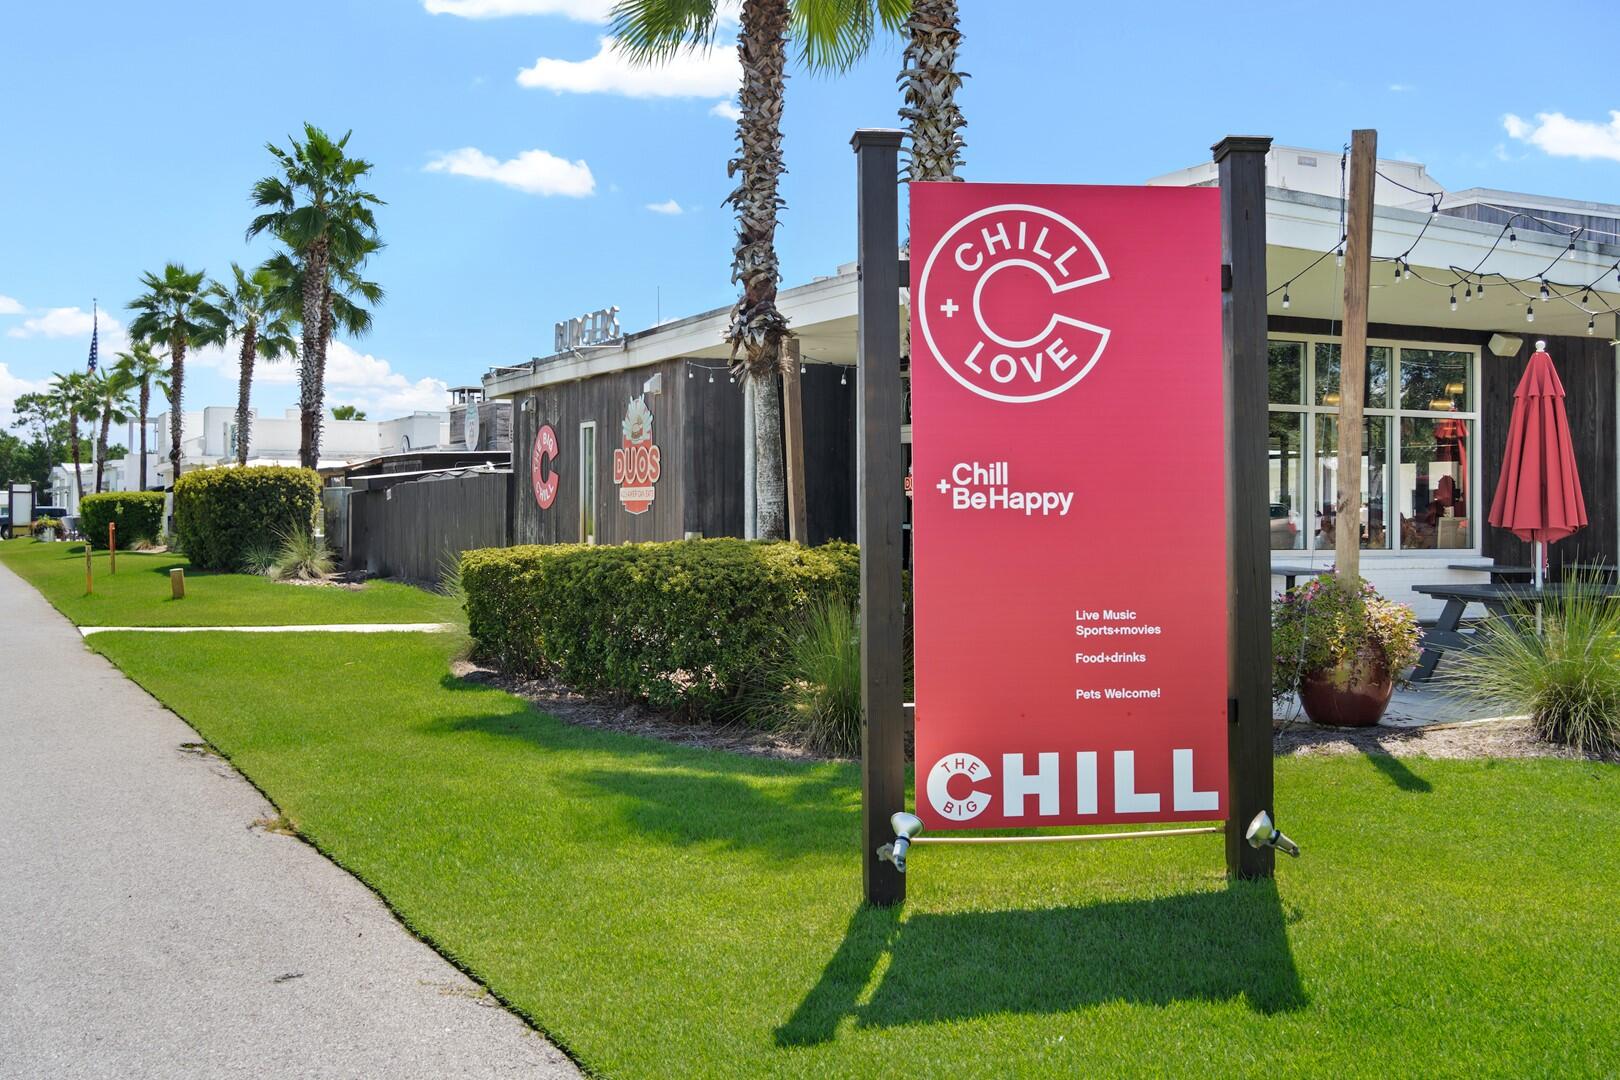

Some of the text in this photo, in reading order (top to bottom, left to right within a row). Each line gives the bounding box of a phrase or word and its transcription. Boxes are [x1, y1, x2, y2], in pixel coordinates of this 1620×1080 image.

[955, 221, 1078, 277] CHILL
[964, 338, 1078, 383] LOVE
[614, 445, 661, 484] DUOS
[952, 462, 1008, 485] Chill
[1076, 609, 1137, 620] Live Music
[1076, 688, 1161, 699] Pets Welcome!
[940, 758, 980, 775] THE
[943, 801, 977, 817] BIG
